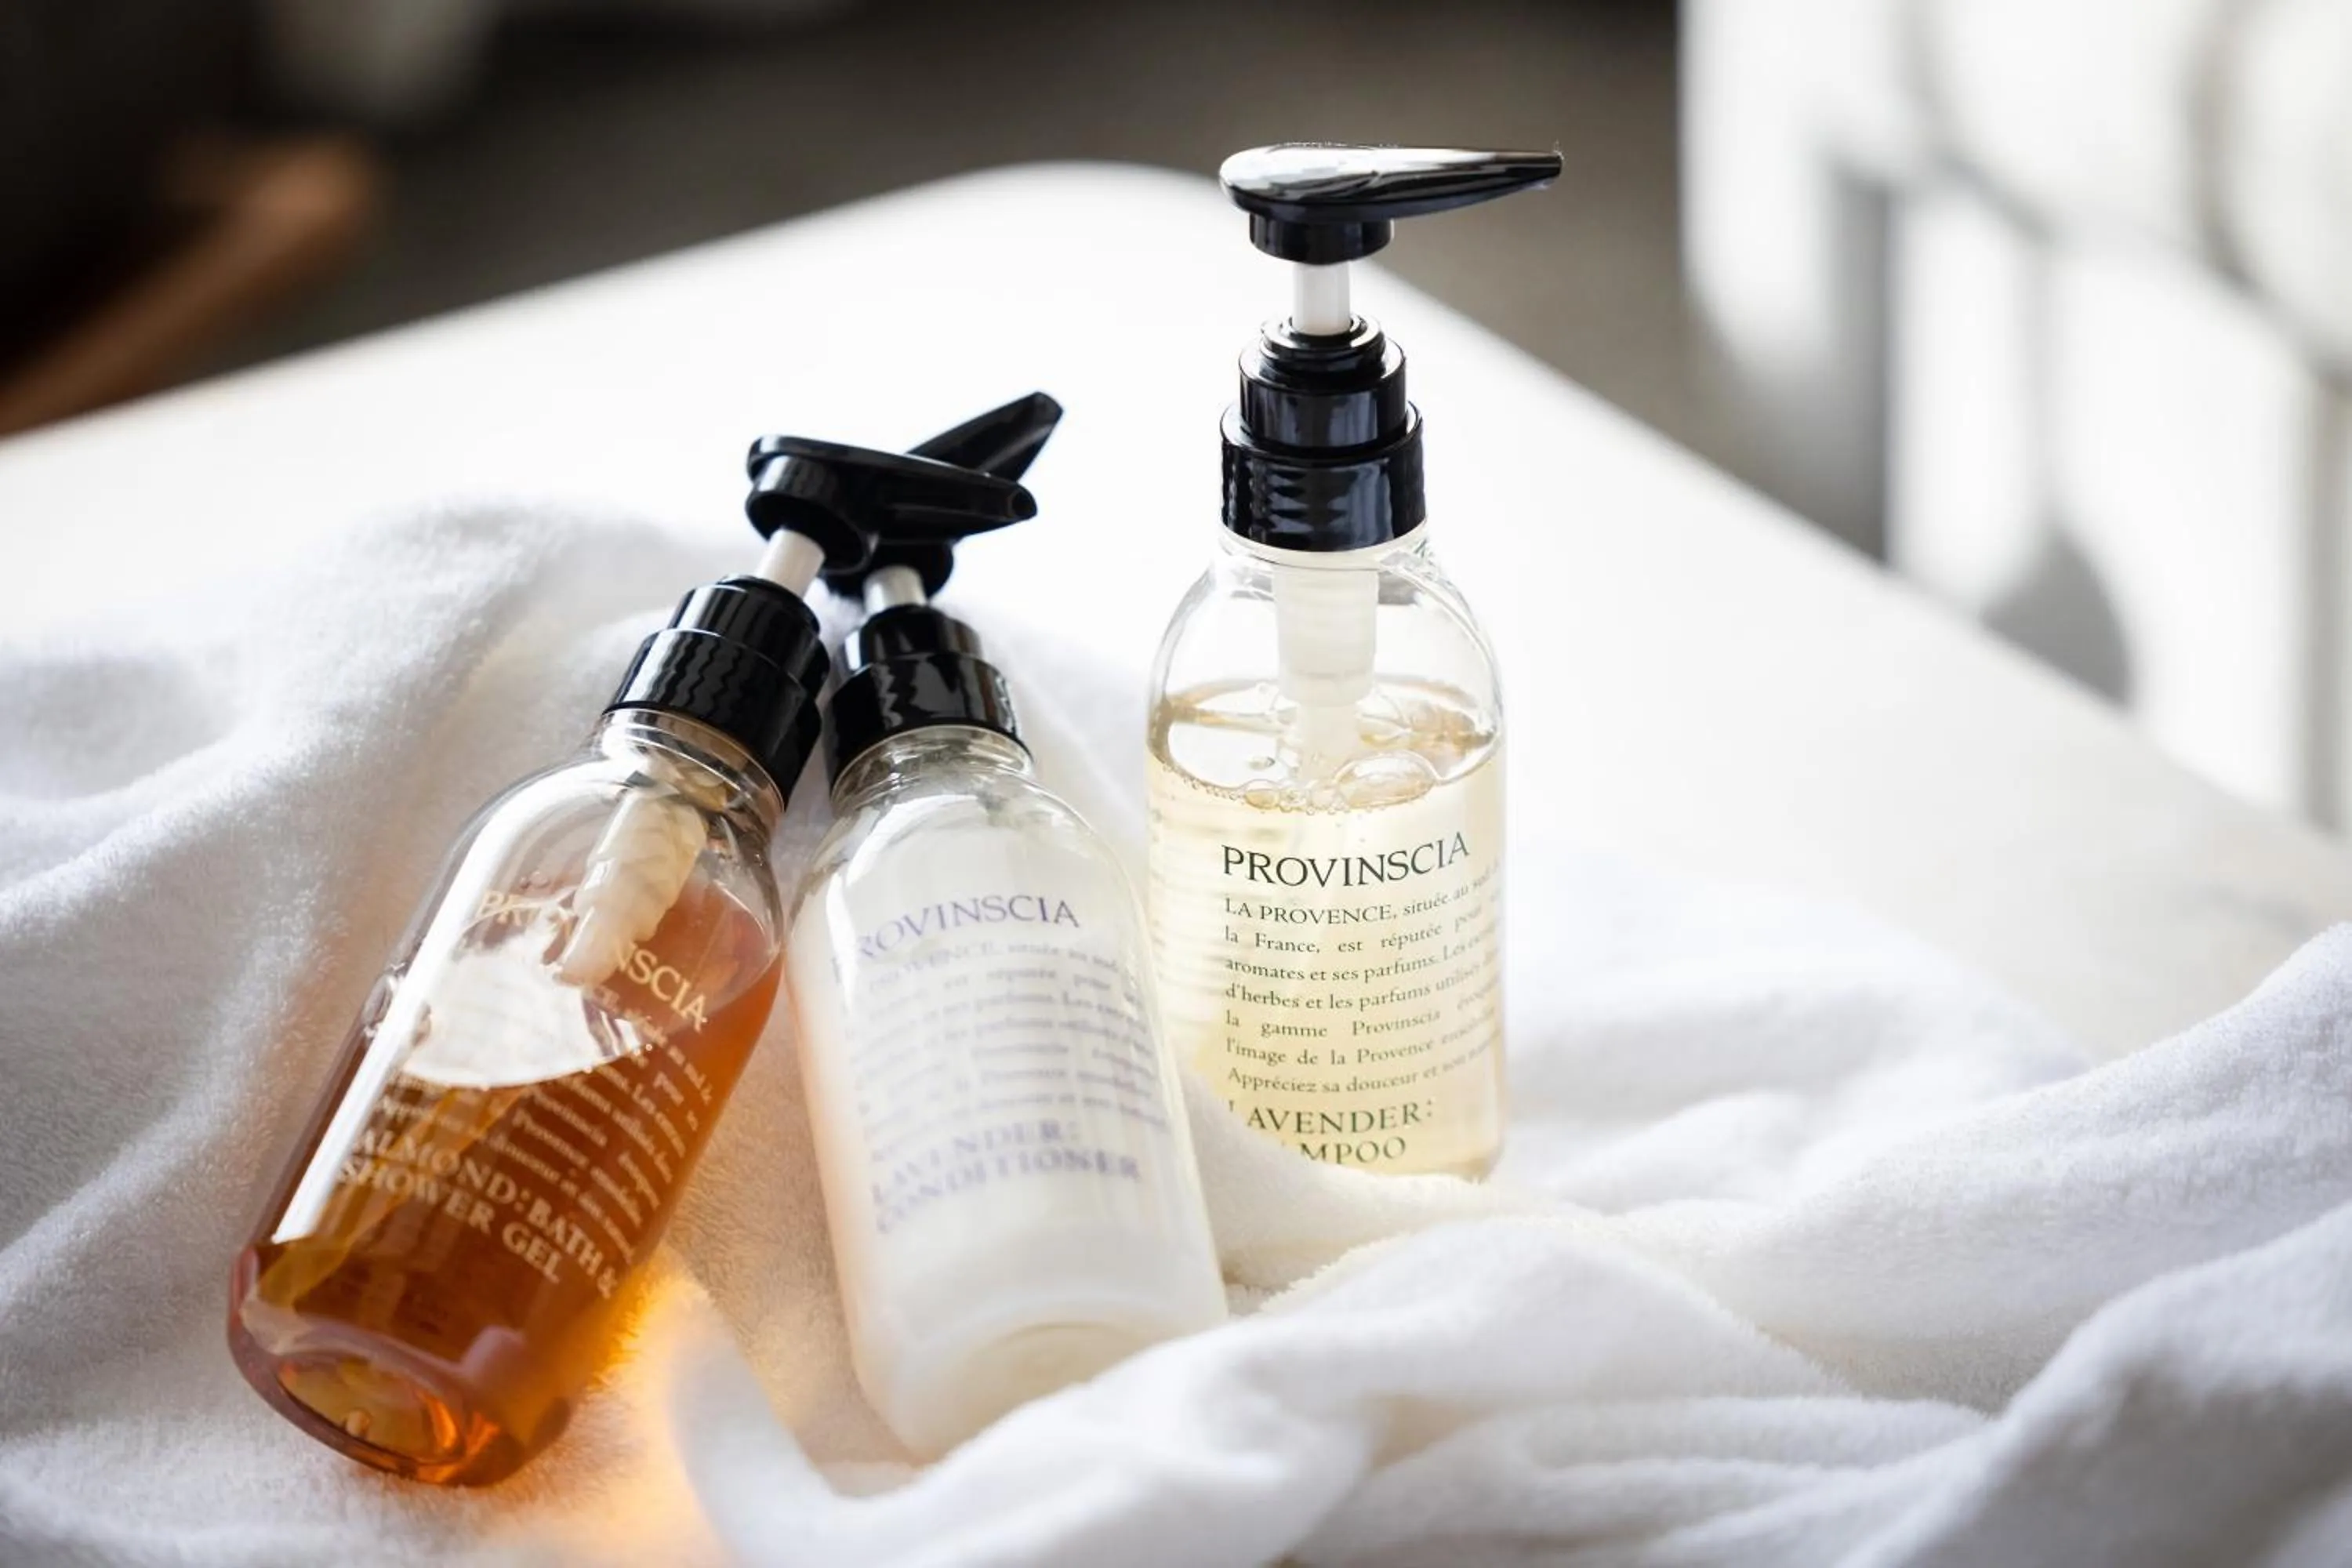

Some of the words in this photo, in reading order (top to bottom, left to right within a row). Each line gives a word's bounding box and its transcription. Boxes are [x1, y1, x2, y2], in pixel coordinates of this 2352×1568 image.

[1221, 831, 1470, 888] PROVINSCIA
[1225, 895, 1253, 919] LA
[1259, 904, 1398, 925] PROVENCE,
[1403, 892, 1449, 916] située
[1225, 924, 1239, 943] la
[1254, 931, 1320, 953] France,
[1338, 940, 1365, 953] est
[1380, 923, 1443, 950] réputée
[1225, 958, 1305, 980] aromates
[1309, 969, 1327, 981] et
[1332, 969, 1359, 981] ses
[1225, 982, 1301, 1008] d'herbes
[1305, 996, 1324, 1009] et
[1330, 993, 1354, 1009] les
[1359, 985, 1432, 1012] parfums
[1225, 1009, 1240, 1028] la
[1261, 1022, 1328, 1038] gamme
[1352, 1009, 1441, 1036] Provinscia
[1226, 1036, 1287, 1067] l'image
[1297, 1049, 1319, 1065] de
[1330, 1049, 1346, 1065] la
[1356, 1039, 1435, 1064] Provence
[1227, 1066, 1318, 1092] Appréciez
[1321, 1083, 1341, 1093] sa
[1345, 1071, 1418, 1093] douceur
[1298, 1136, 1406, 1165] MPOO
[502, 1221, 561, 1284] GEL
